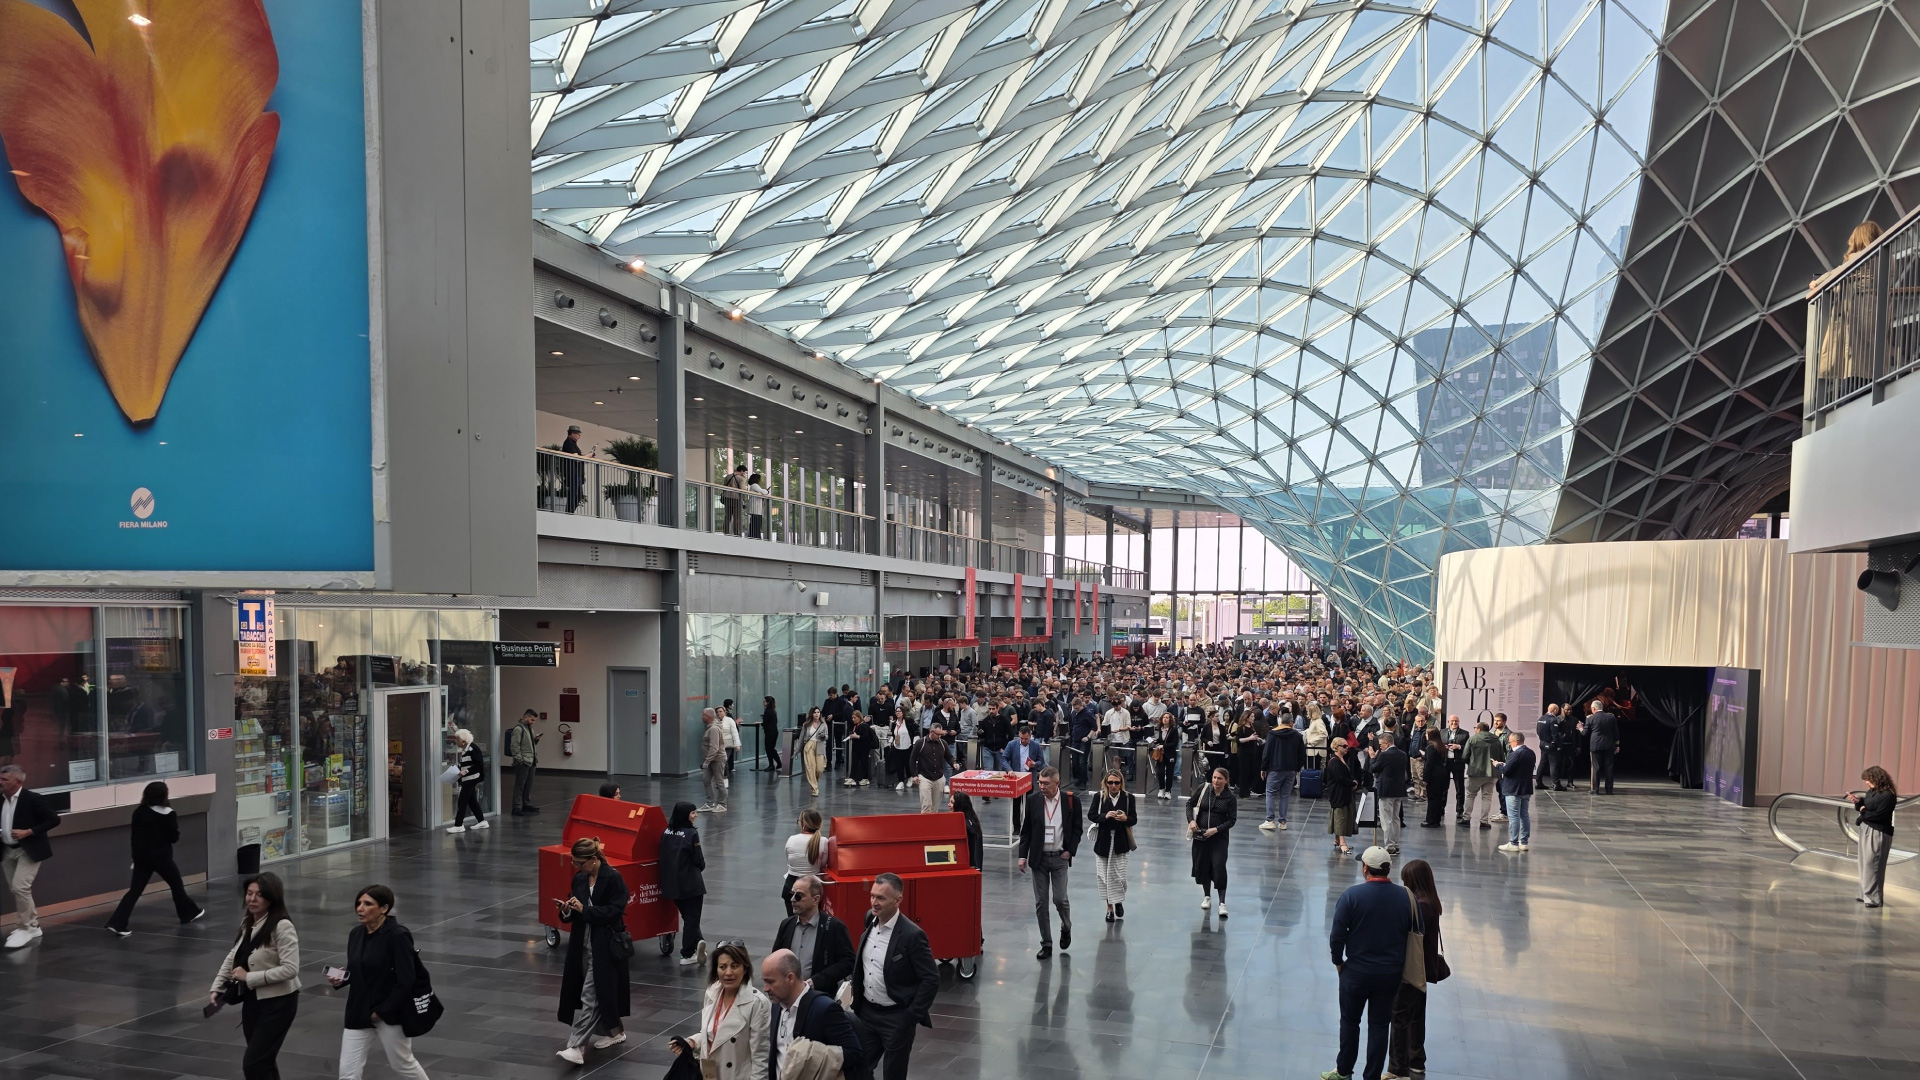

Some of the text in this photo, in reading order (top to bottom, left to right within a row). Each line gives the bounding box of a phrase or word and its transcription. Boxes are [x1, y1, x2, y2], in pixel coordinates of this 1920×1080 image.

[119, 521, 139, 529] FIERA
[243, 602, 261, 630] T
[240, 631, 266, 642] TABACCHI
[501, 644, 552, 652] Business Point
[1452, 666, 1487, 690] AB
[1468, 688, 1495, 711] IT
[639, 883, 658, 891] Salone
[639, 897, 658, 905] Milano
